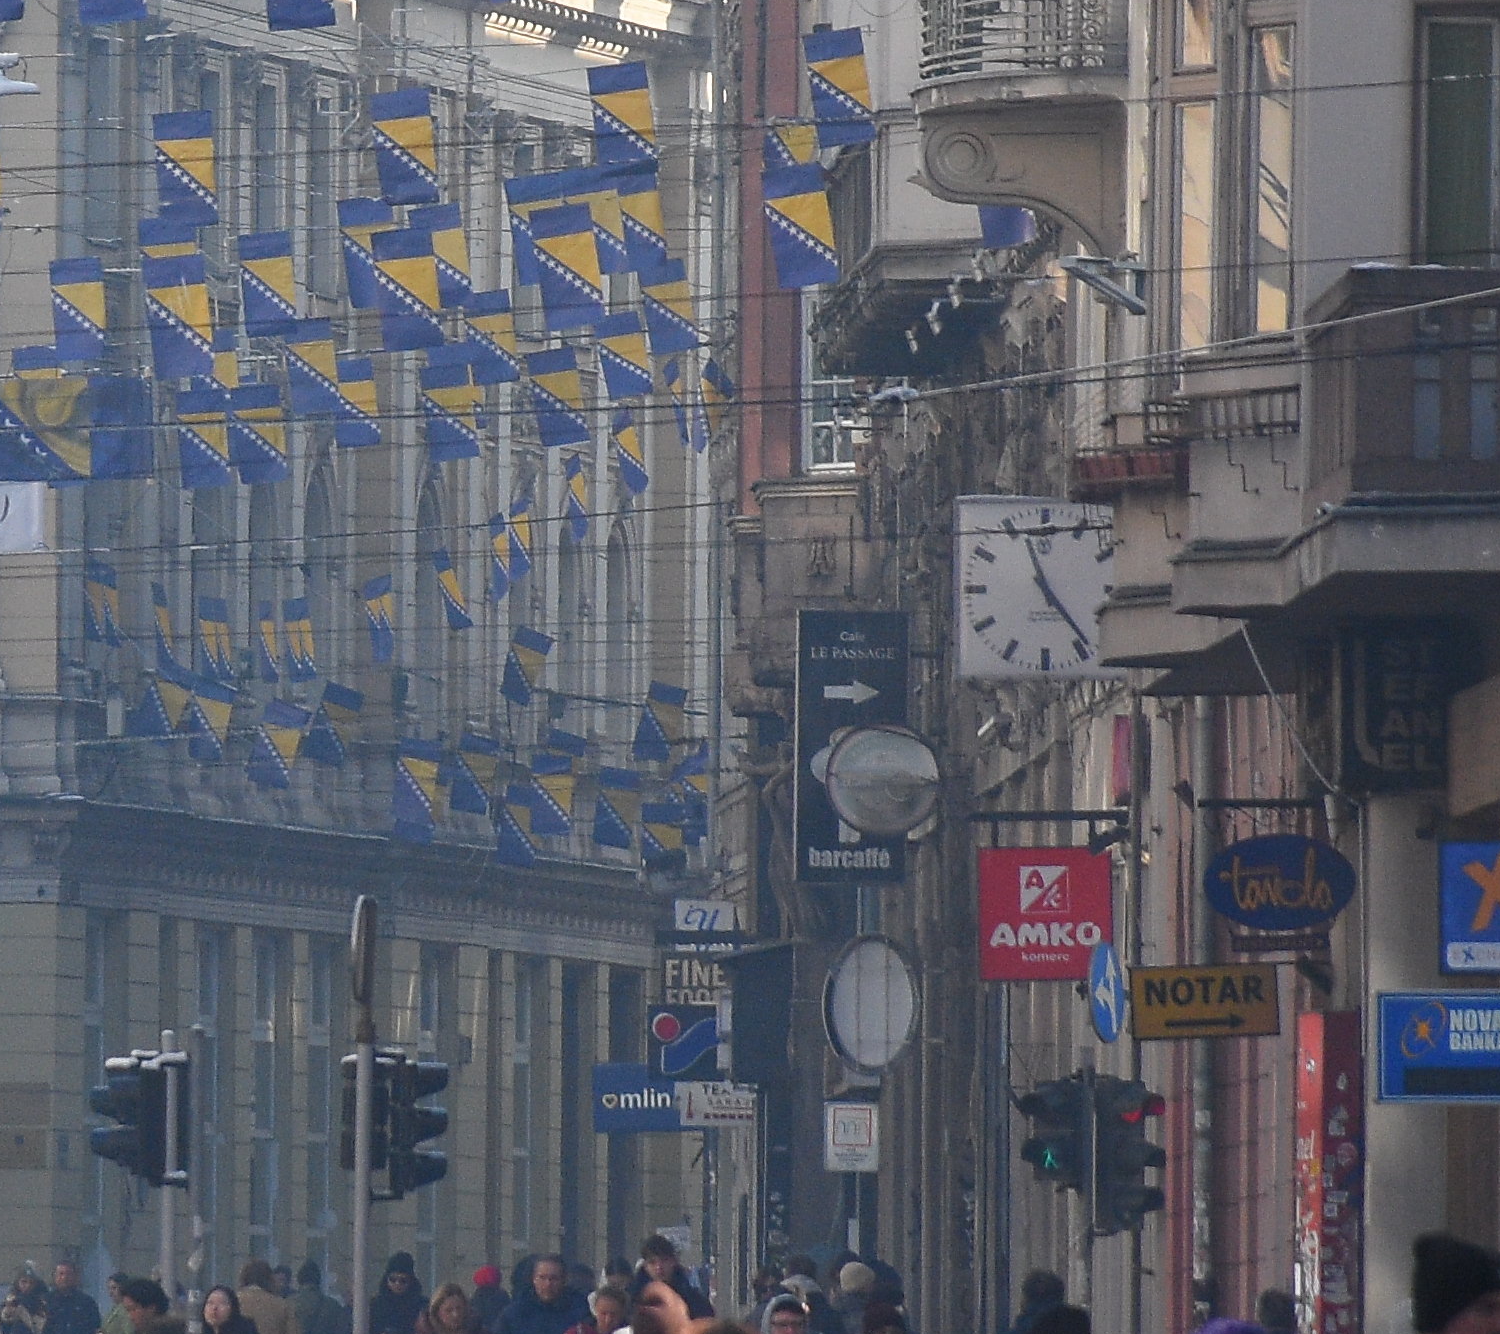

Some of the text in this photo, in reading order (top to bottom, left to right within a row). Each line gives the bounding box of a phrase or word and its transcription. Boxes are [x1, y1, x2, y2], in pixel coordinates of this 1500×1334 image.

[832, 646, 896, 660] PASSAGE
[989, 921, 1101, 947] AMKO
[1143, 975, 1264, 1008] NOTAR
[620, 1089, 672, 1109] mlin
